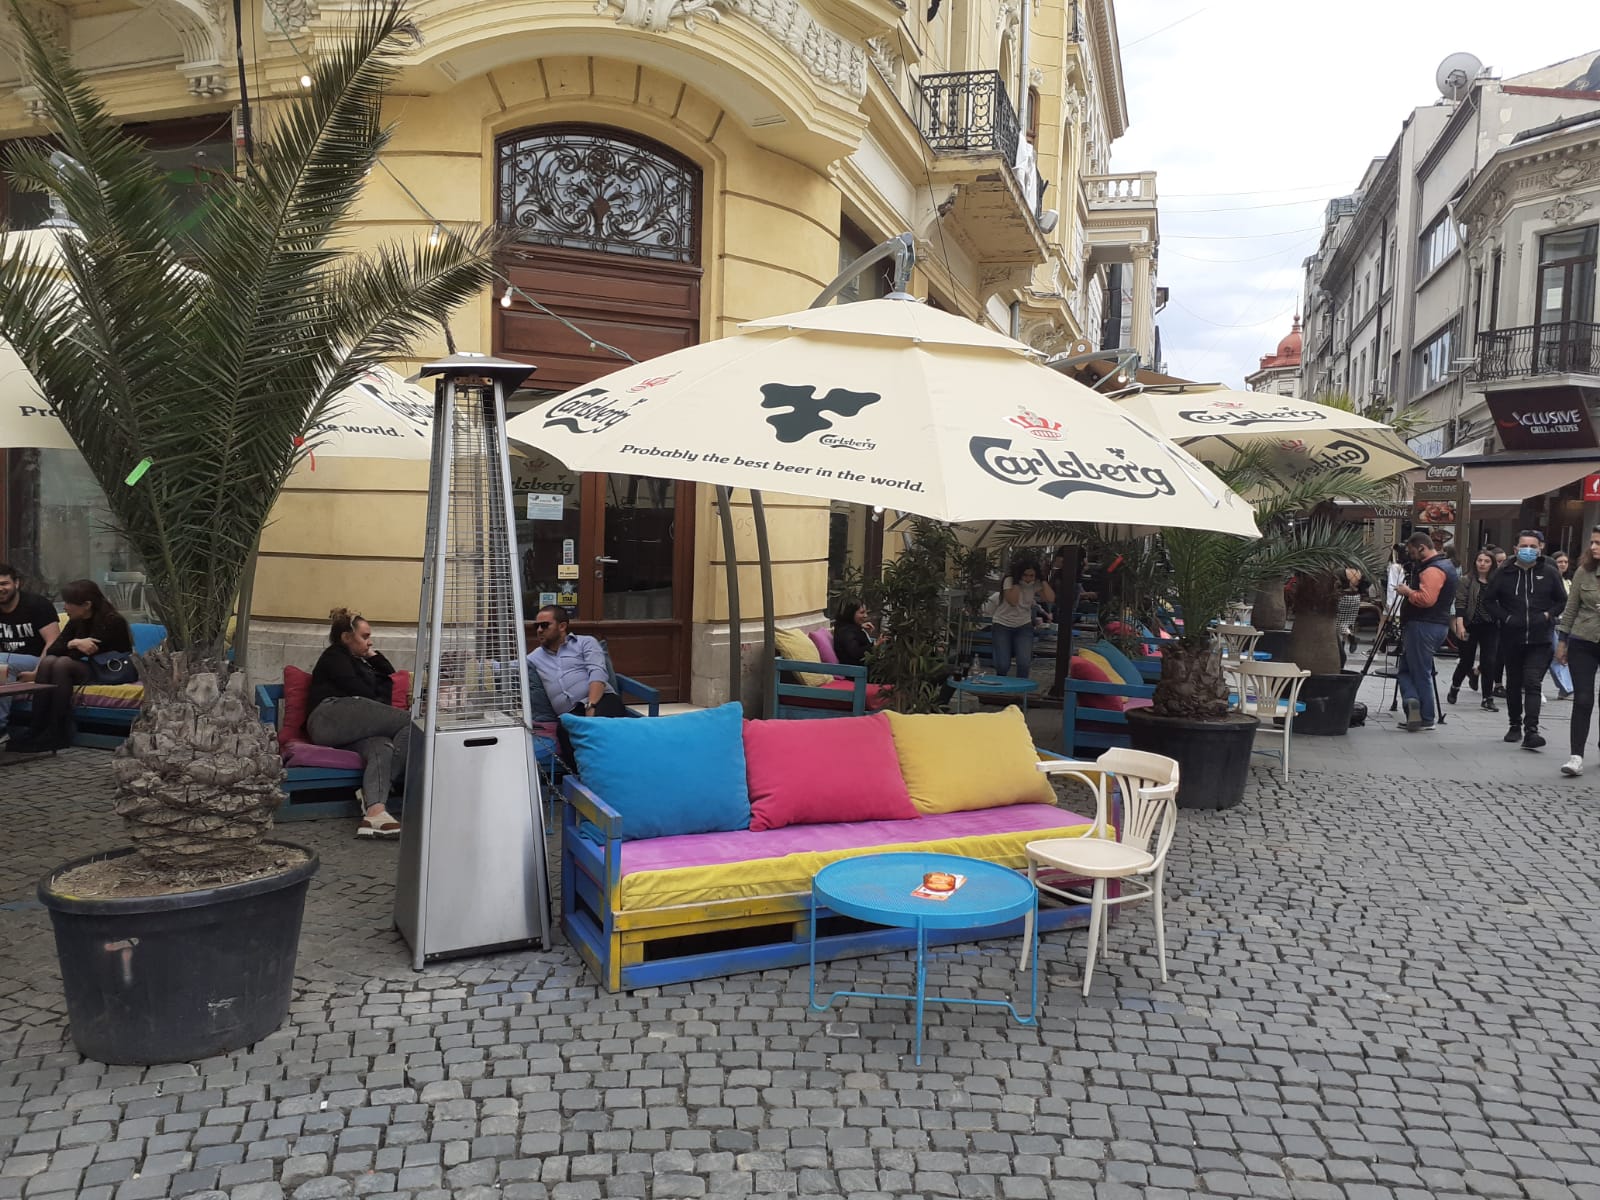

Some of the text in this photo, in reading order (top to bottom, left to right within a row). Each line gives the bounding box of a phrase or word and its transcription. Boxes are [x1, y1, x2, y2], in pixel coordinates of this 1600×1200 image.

[543, 388, 632, 433] Carlsberg
[1178, 408, 1327, 426] Carlsberg
[819, 434, 876, 450] Carlsberg
[620, 444, 925, 493] Probably the best beer in the world.
[969, 436, 1176, 499] Carlsberg
